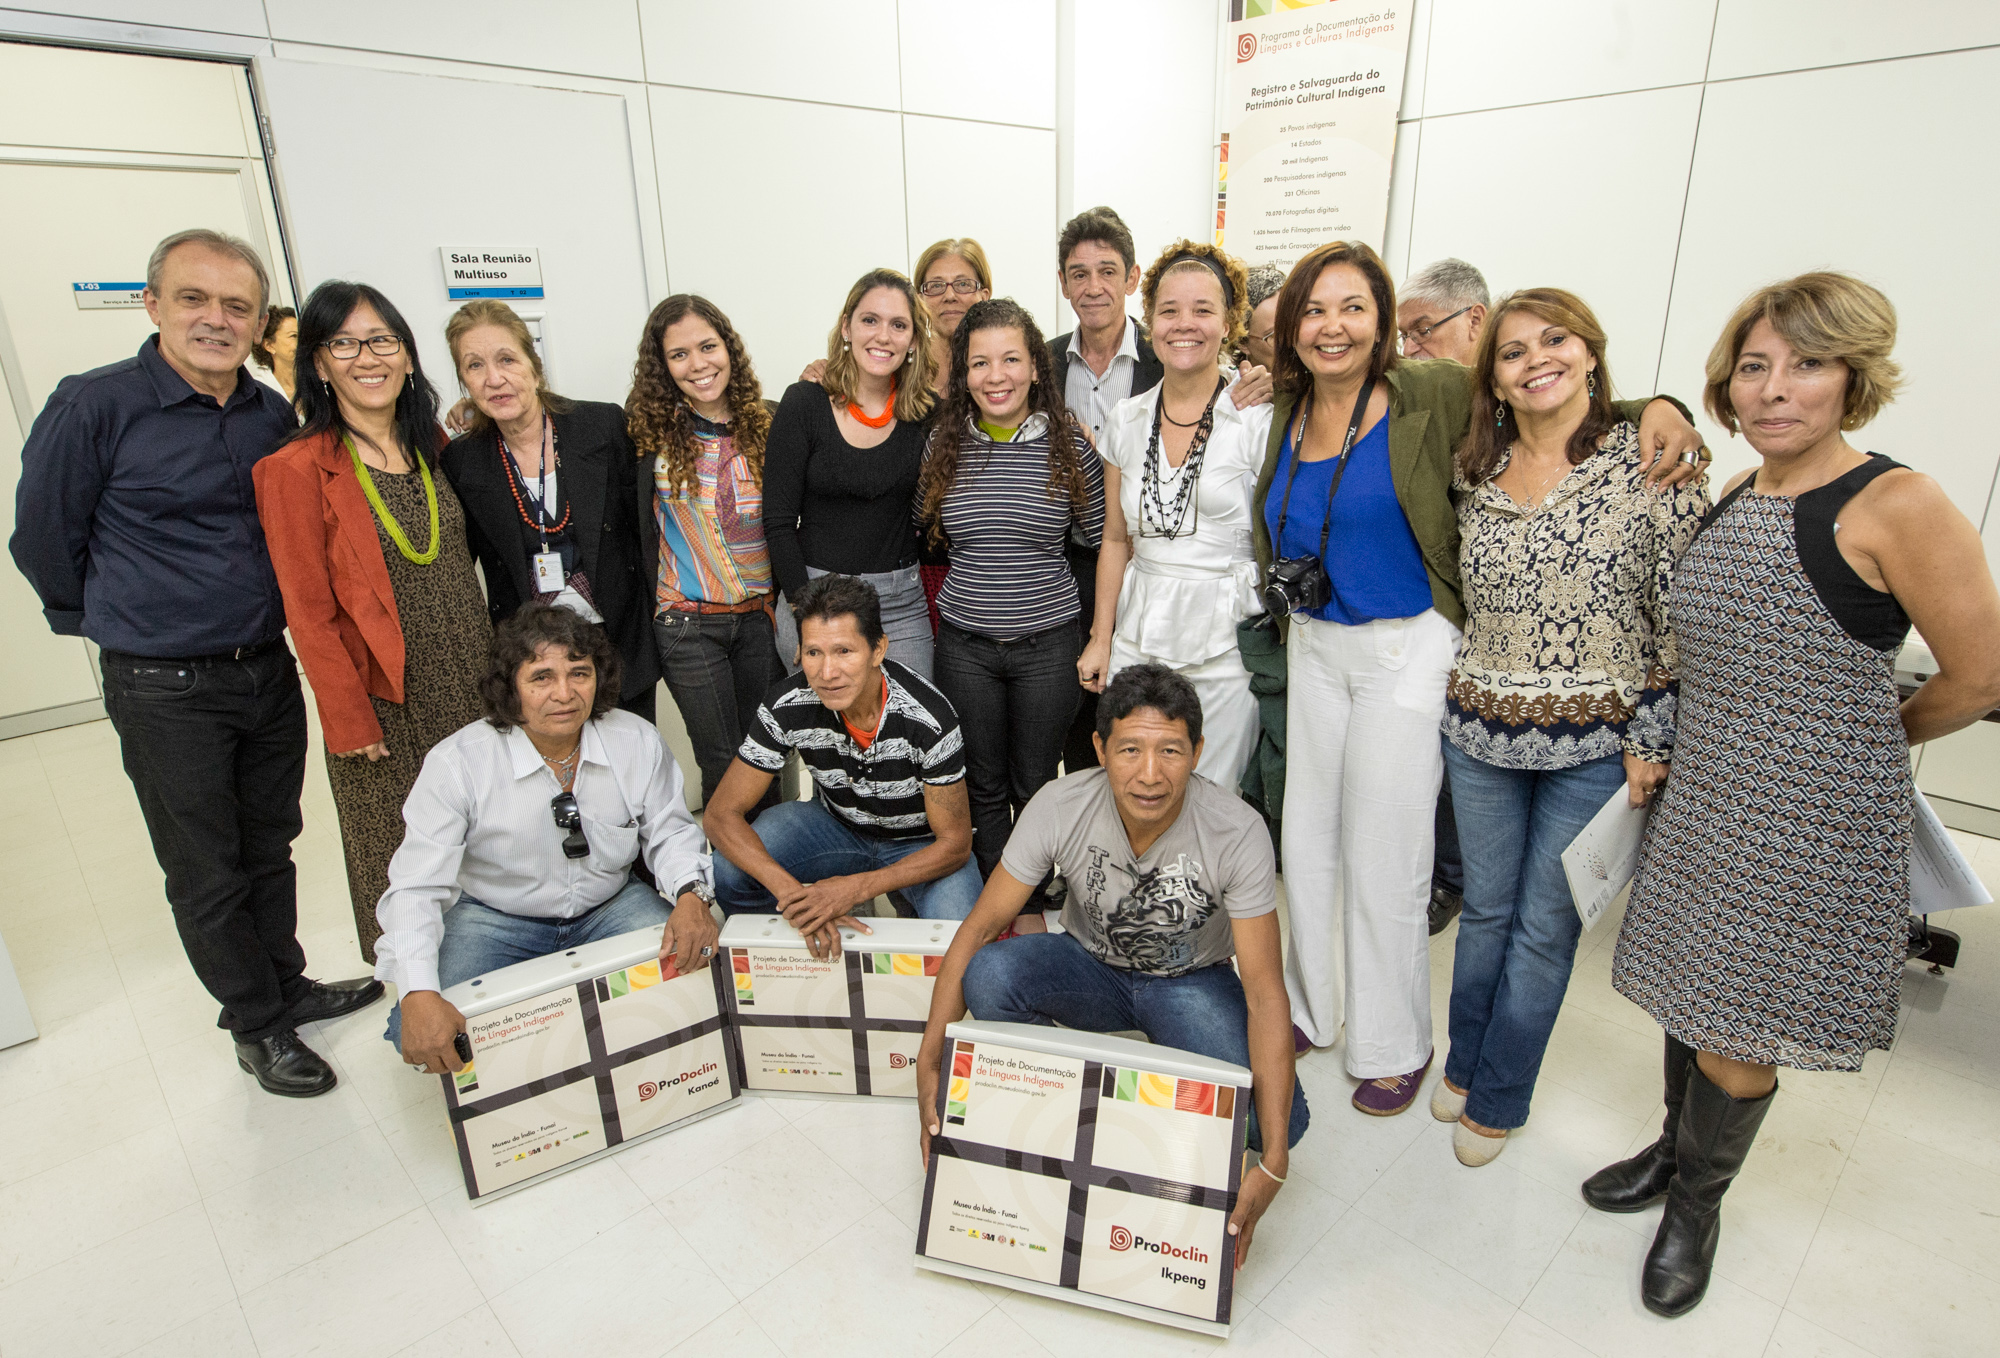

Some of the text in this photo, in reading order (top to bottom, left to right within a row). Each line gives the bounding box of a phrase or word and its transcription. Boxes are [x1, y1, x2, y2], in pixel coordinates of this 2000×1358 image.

[1261, 8, 1396, 43] Programa de Documentação de
[1260, 43, 1292, 54] Línguas
[1305, 32, 1342, 45] Culturas
[1346, 24, 1395, 38] Indígenas
[1251, 69, 1380, 97] Registro e Salvaguarda do
[1245, 85, 1386, 112] Patrimônio Cultural Indígena
[1288, 124, 1305, 132] Povos
[1299, 139, 1322, 147] Estados
[1274, 173, 1315, 182] Pesquisadores
[1295, 189, 1320, 197] Oficinas
[1283, 207, 1315, 216] Fotografias
[1317, 206, 1339, 214] digitais
[1290, 226, 1321, 234] Filmagens
[1288, 242, 1319, 250] Gravações
[451, 254, 532, 263] Sala Reunião
[454, 269, 508, 279] Multiuso
[753, 955, 840, 965] Projeto de Documenção
[765, 964, 793, 973] Línguas
[795, 964, 831, 973] Indígenas
[472, 997, 572, 1034] Projeto de Documentação
[474, 1010, 564, 1044] de Línguas Indígenas
[978, 1054, 1077, 1079] Projeto de Documentação
[659, 1062, 718, 1091] ProDoclin
[976, 1065, 1064, 1089] de Línguas Indígenas
[688, 1077, 719, 1095] Kanoé
[492, 1139, 511, 1149] Museu
[953, 1199, 972, 1209] Museu
[1001, 1210, 1018, 1219] Funai
[1134, 1235, 1208, 1264] ProDoclin
[1161, 1267, 1206, 1290] Ikpeng
